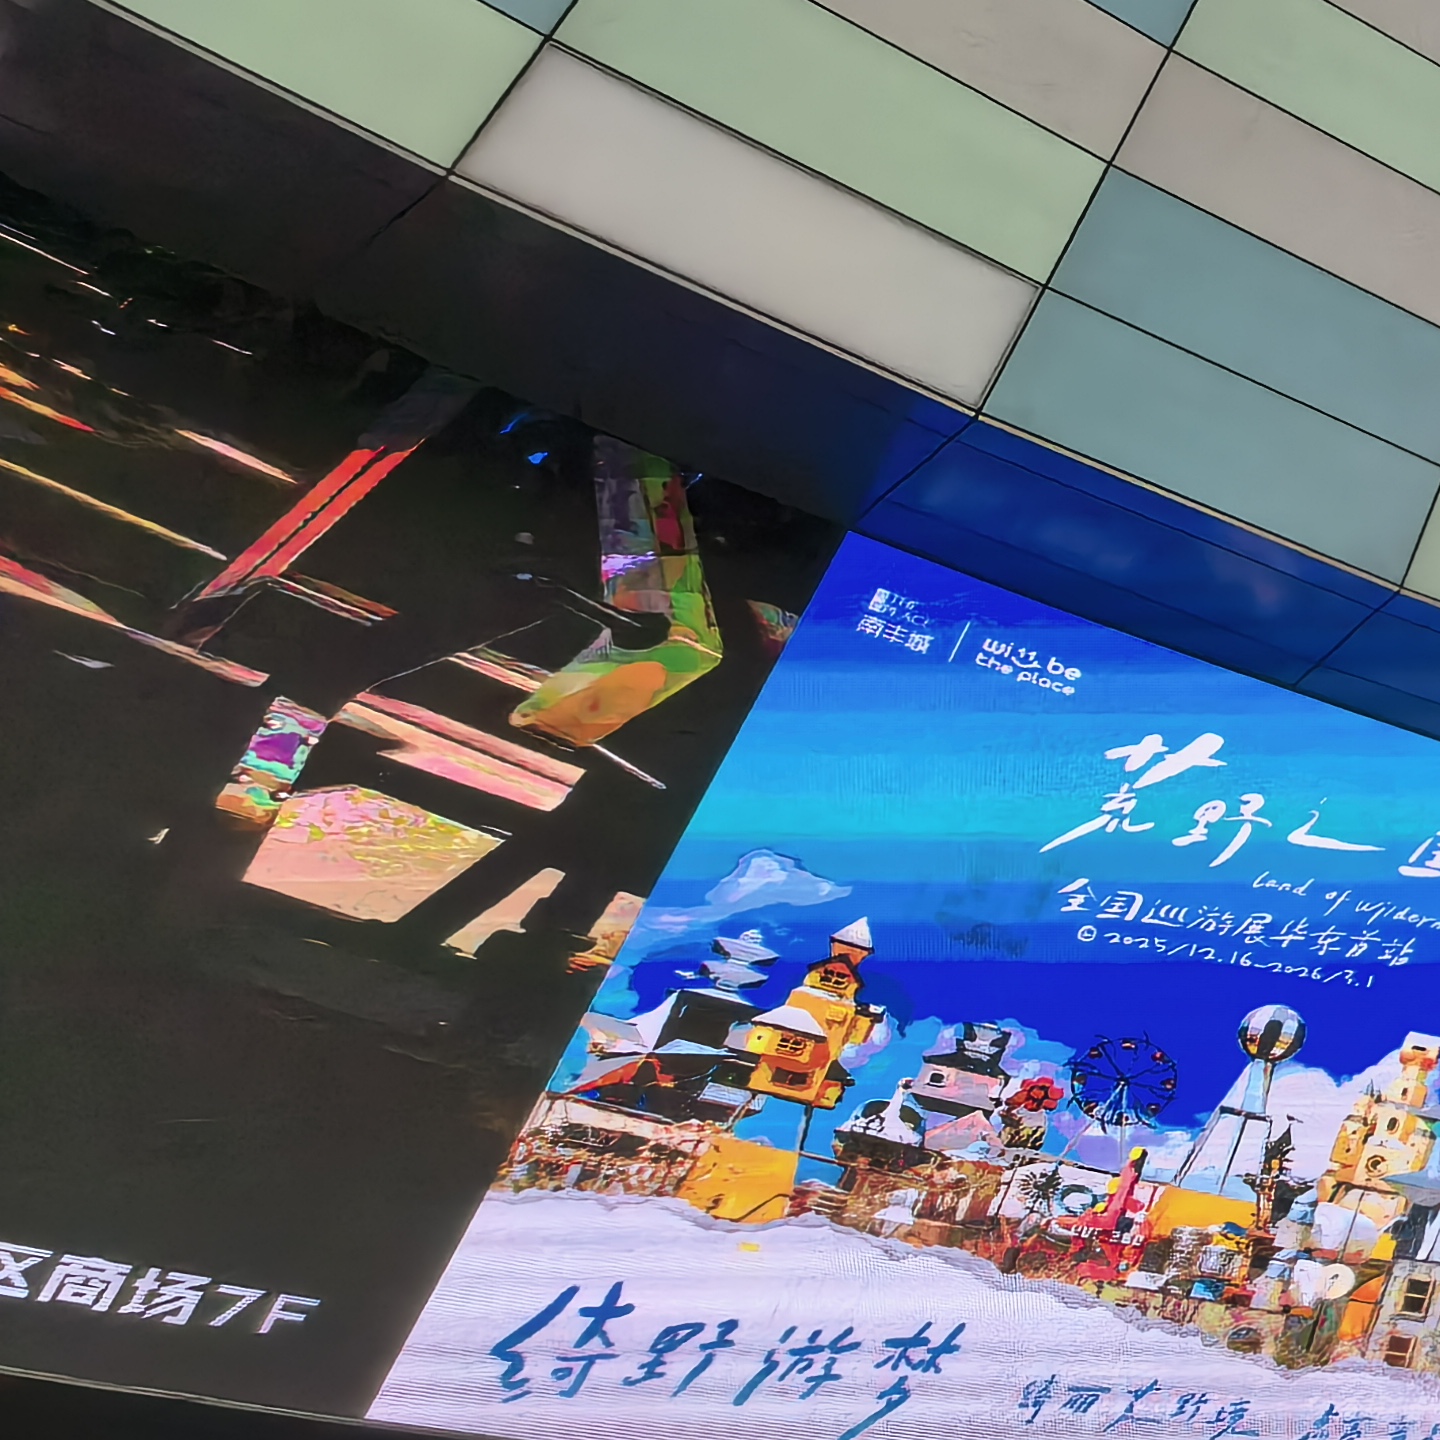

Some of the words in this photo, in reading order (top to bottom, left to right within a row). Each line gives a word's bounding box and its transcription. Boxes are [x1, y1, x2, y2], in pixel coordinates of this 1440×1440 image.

[975, 651, 1014, 675] the
[1016, 670, 1076, 696] place
[1046, 656, 1082, 681] be
[1057, 877, 1418, 967] 全国巡游展华东首站
